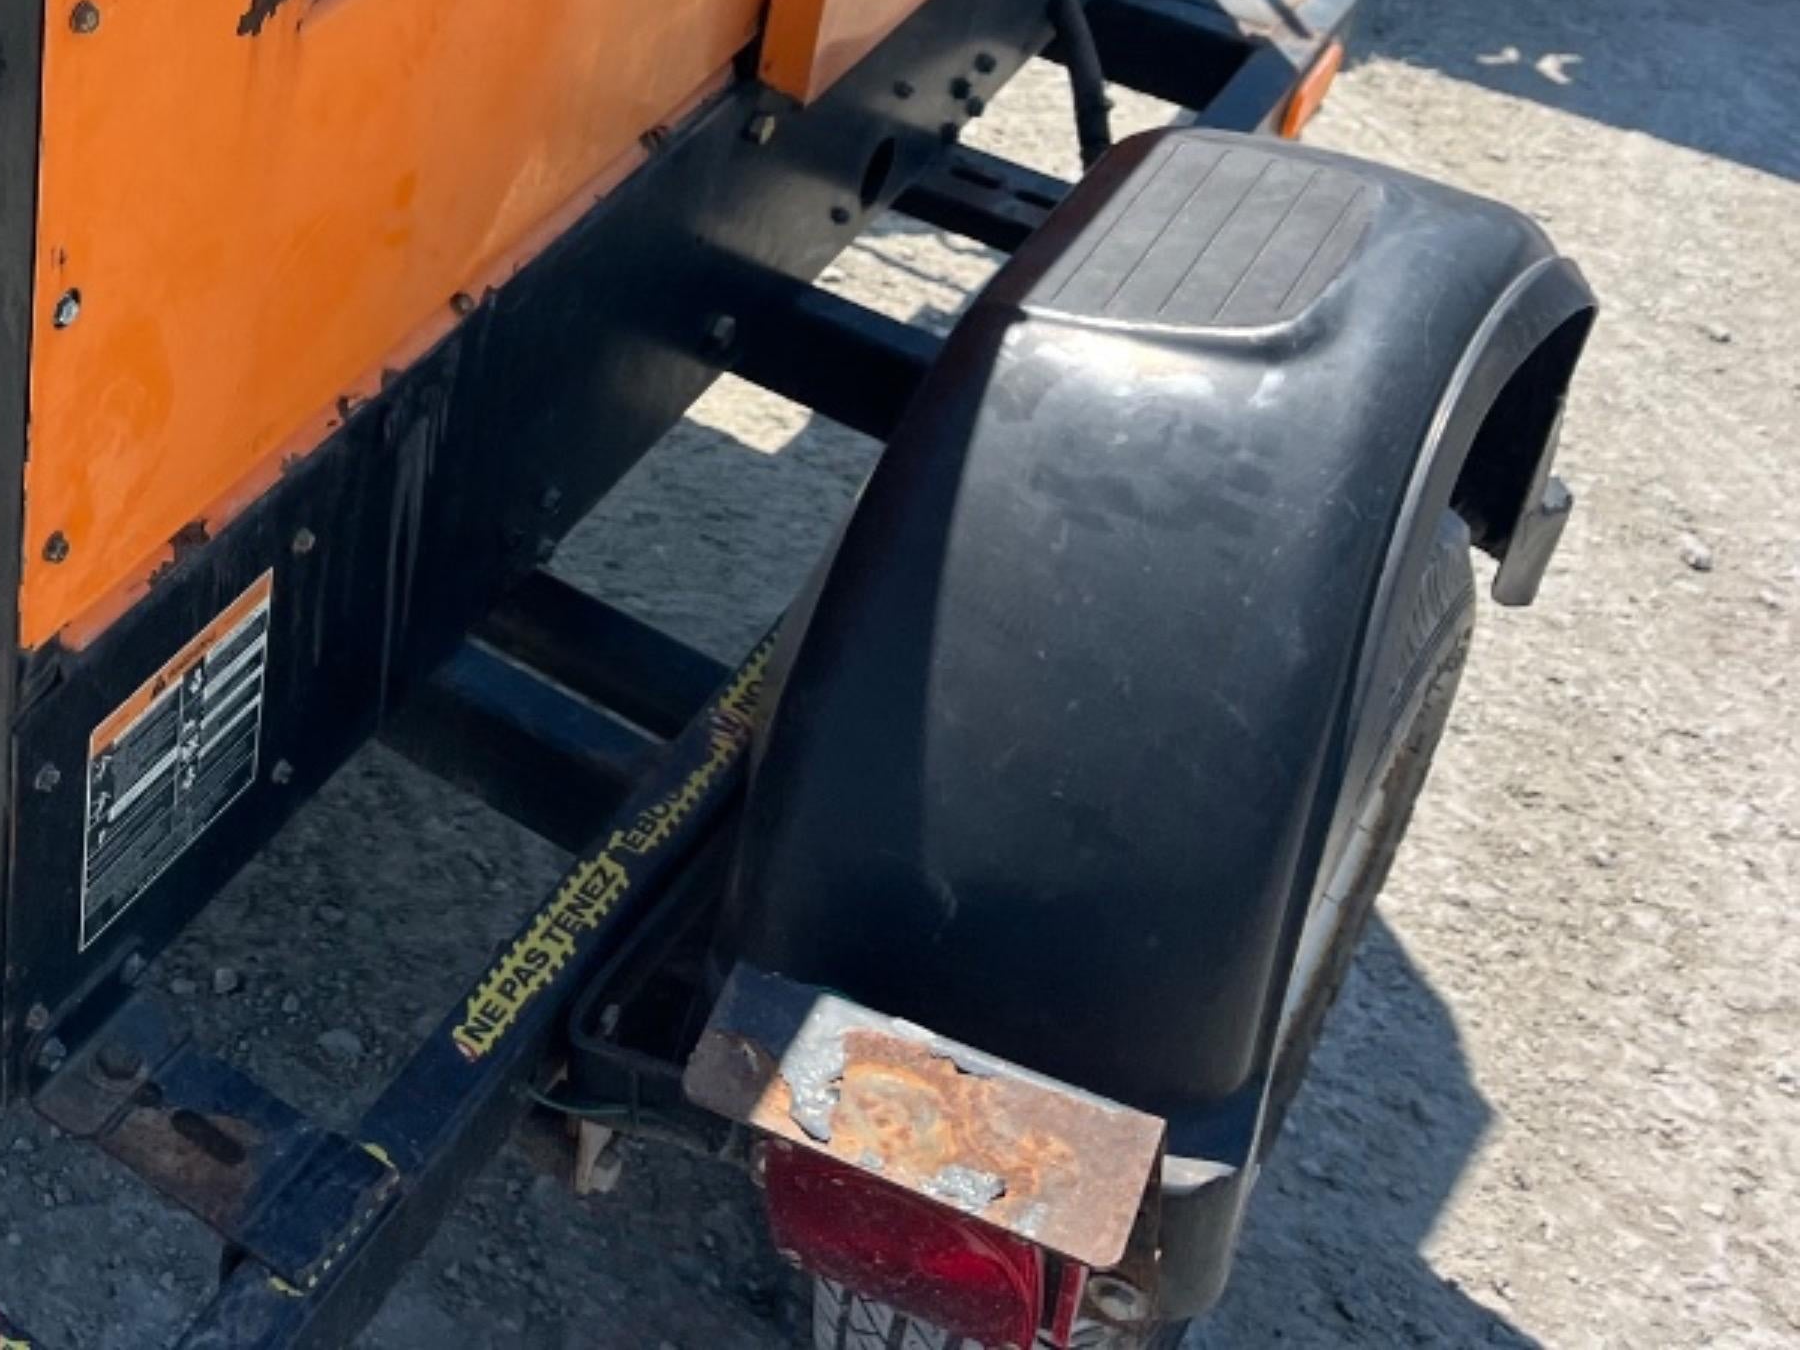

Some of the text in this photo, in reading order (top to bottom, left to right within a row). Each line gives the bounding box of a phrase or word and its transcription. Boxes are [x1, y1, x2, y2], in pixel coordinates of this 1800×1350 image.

[464, 998, 507, 1043] NE
[497, 947, 551, 1002] PAS
[540, 865, 618, 945] TENEZ
